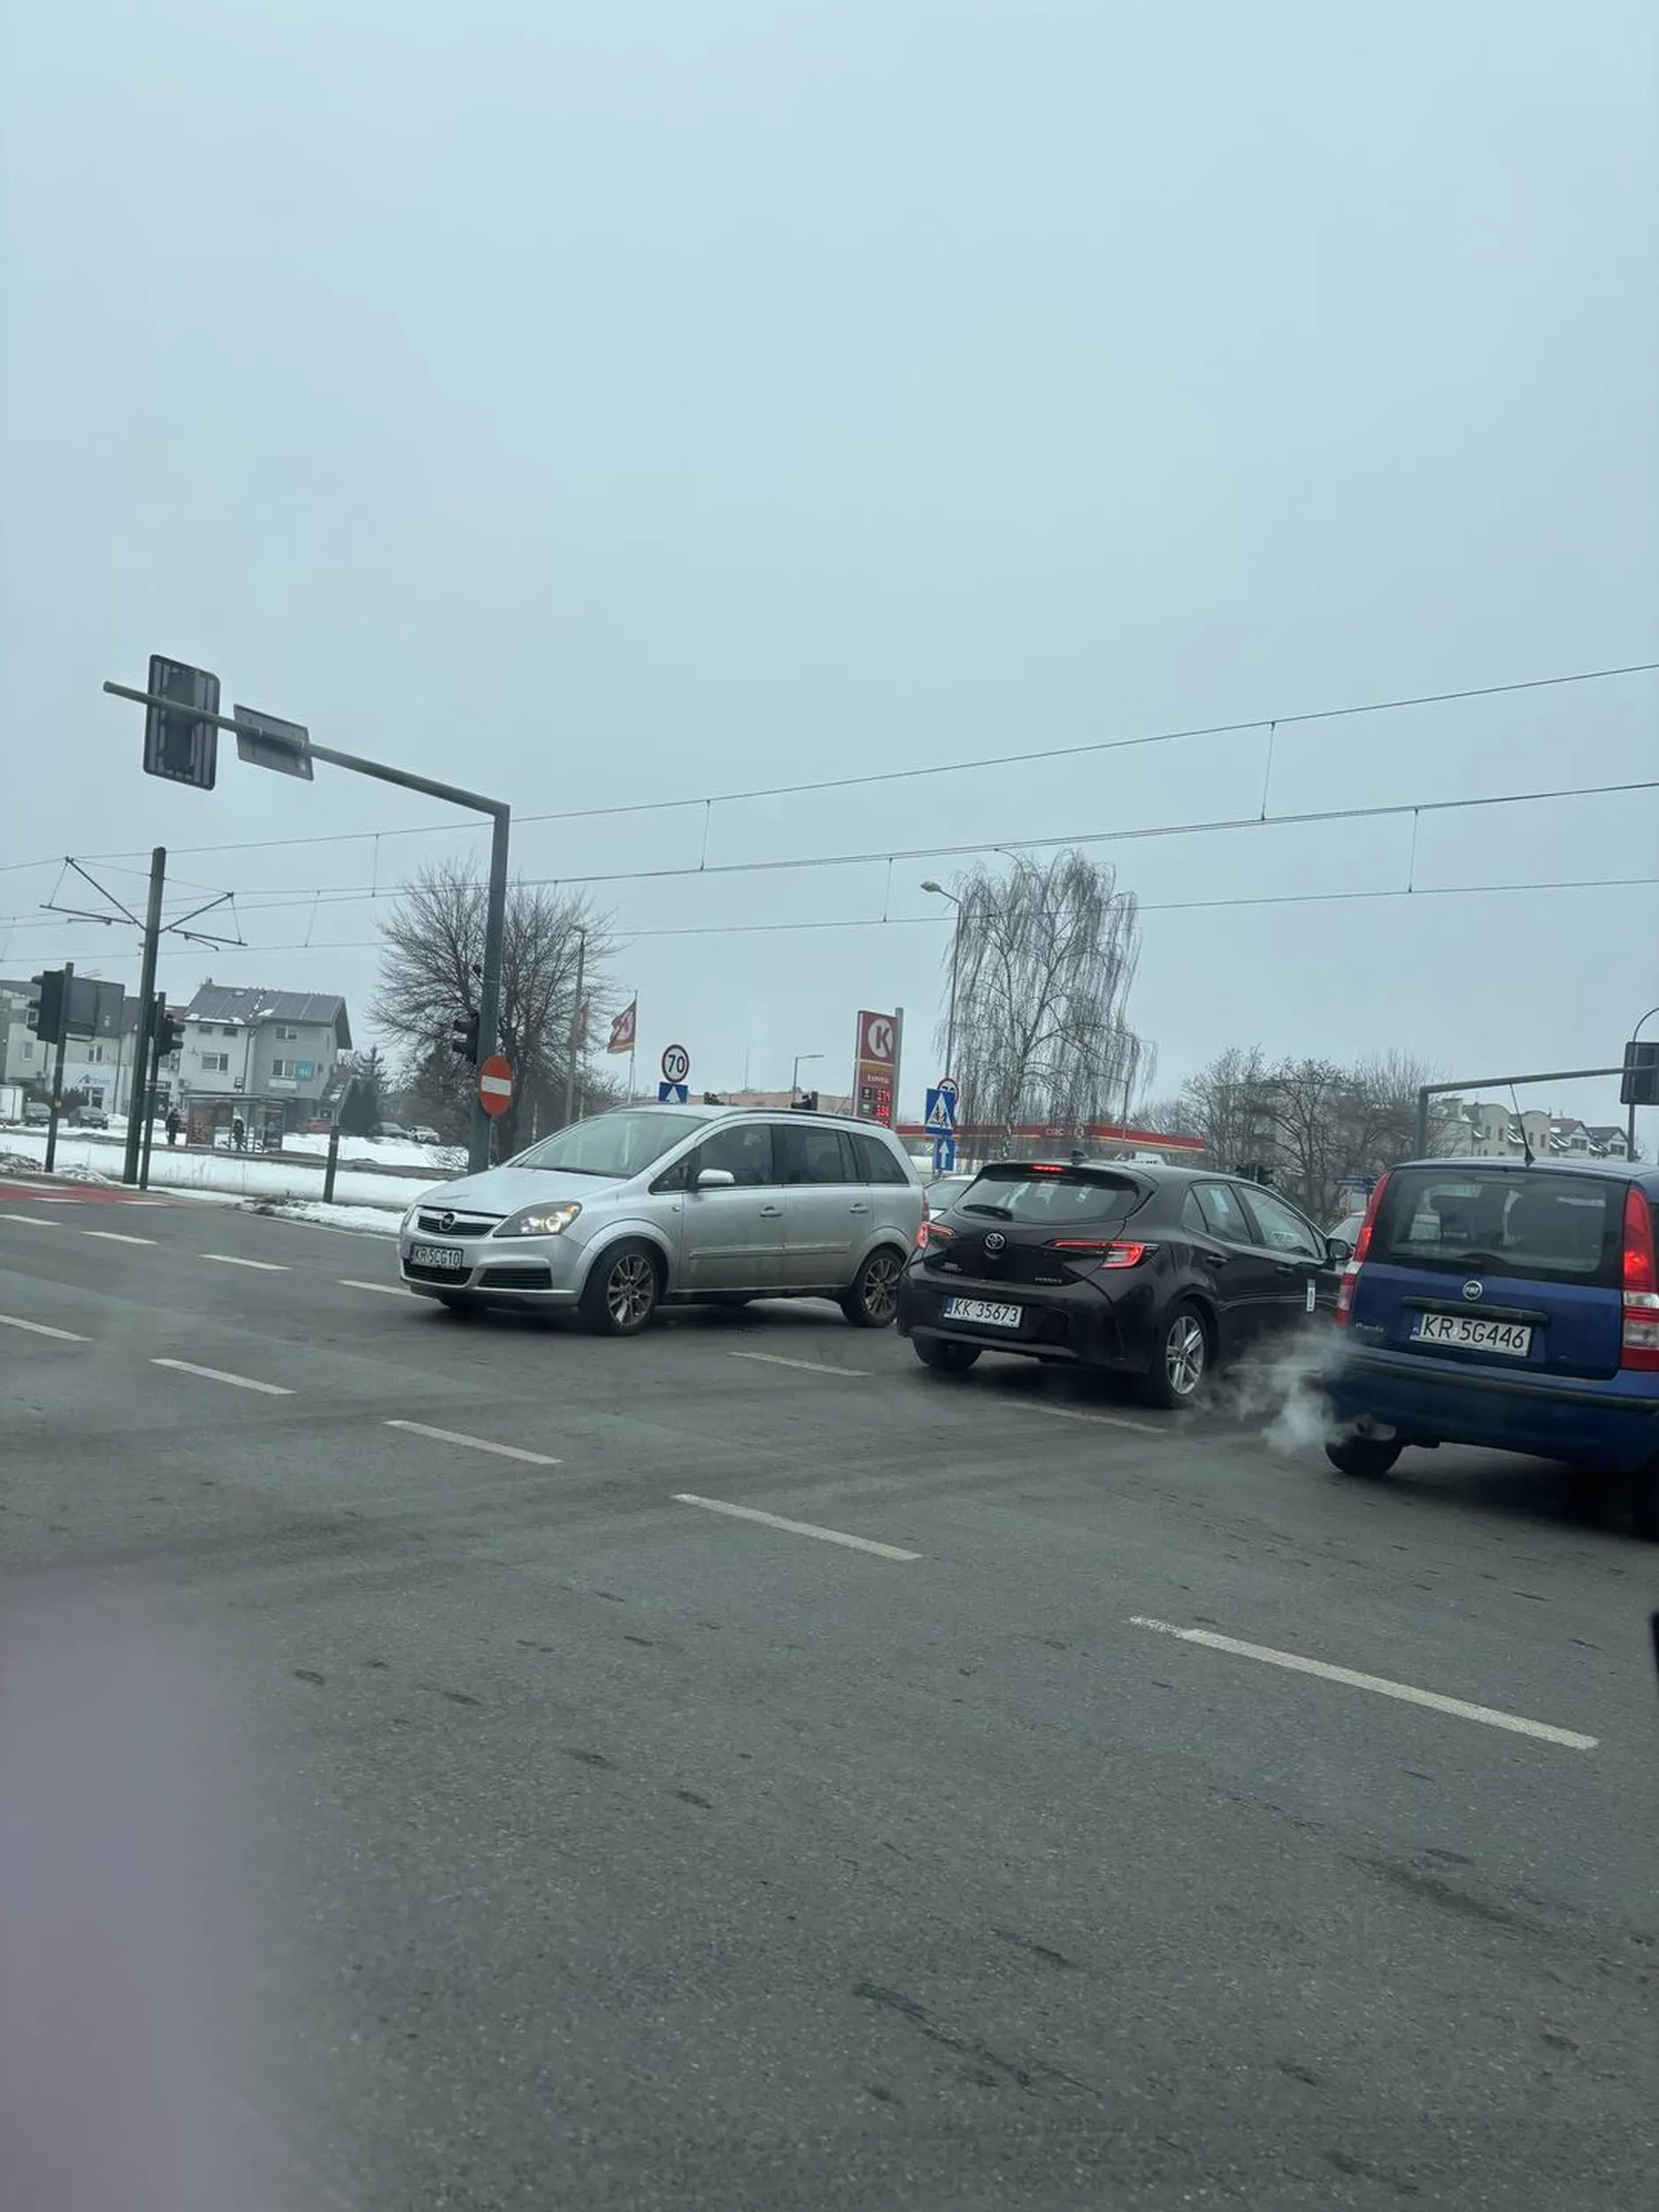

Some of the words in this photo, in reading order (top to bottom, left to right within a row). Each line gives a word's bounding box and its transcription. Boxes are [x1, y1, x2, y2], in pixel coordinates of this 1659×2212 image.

[875, 1025, 892, 1054] K
[668, 1054, 686, 1074] 70
[953, 1299, 972, 1317] KK
[976, 1302, 1018, 1323] 35673
[1423, 1316, 1454, 1340] KR
[1459, 1320, 1526, 1349] 5G446
